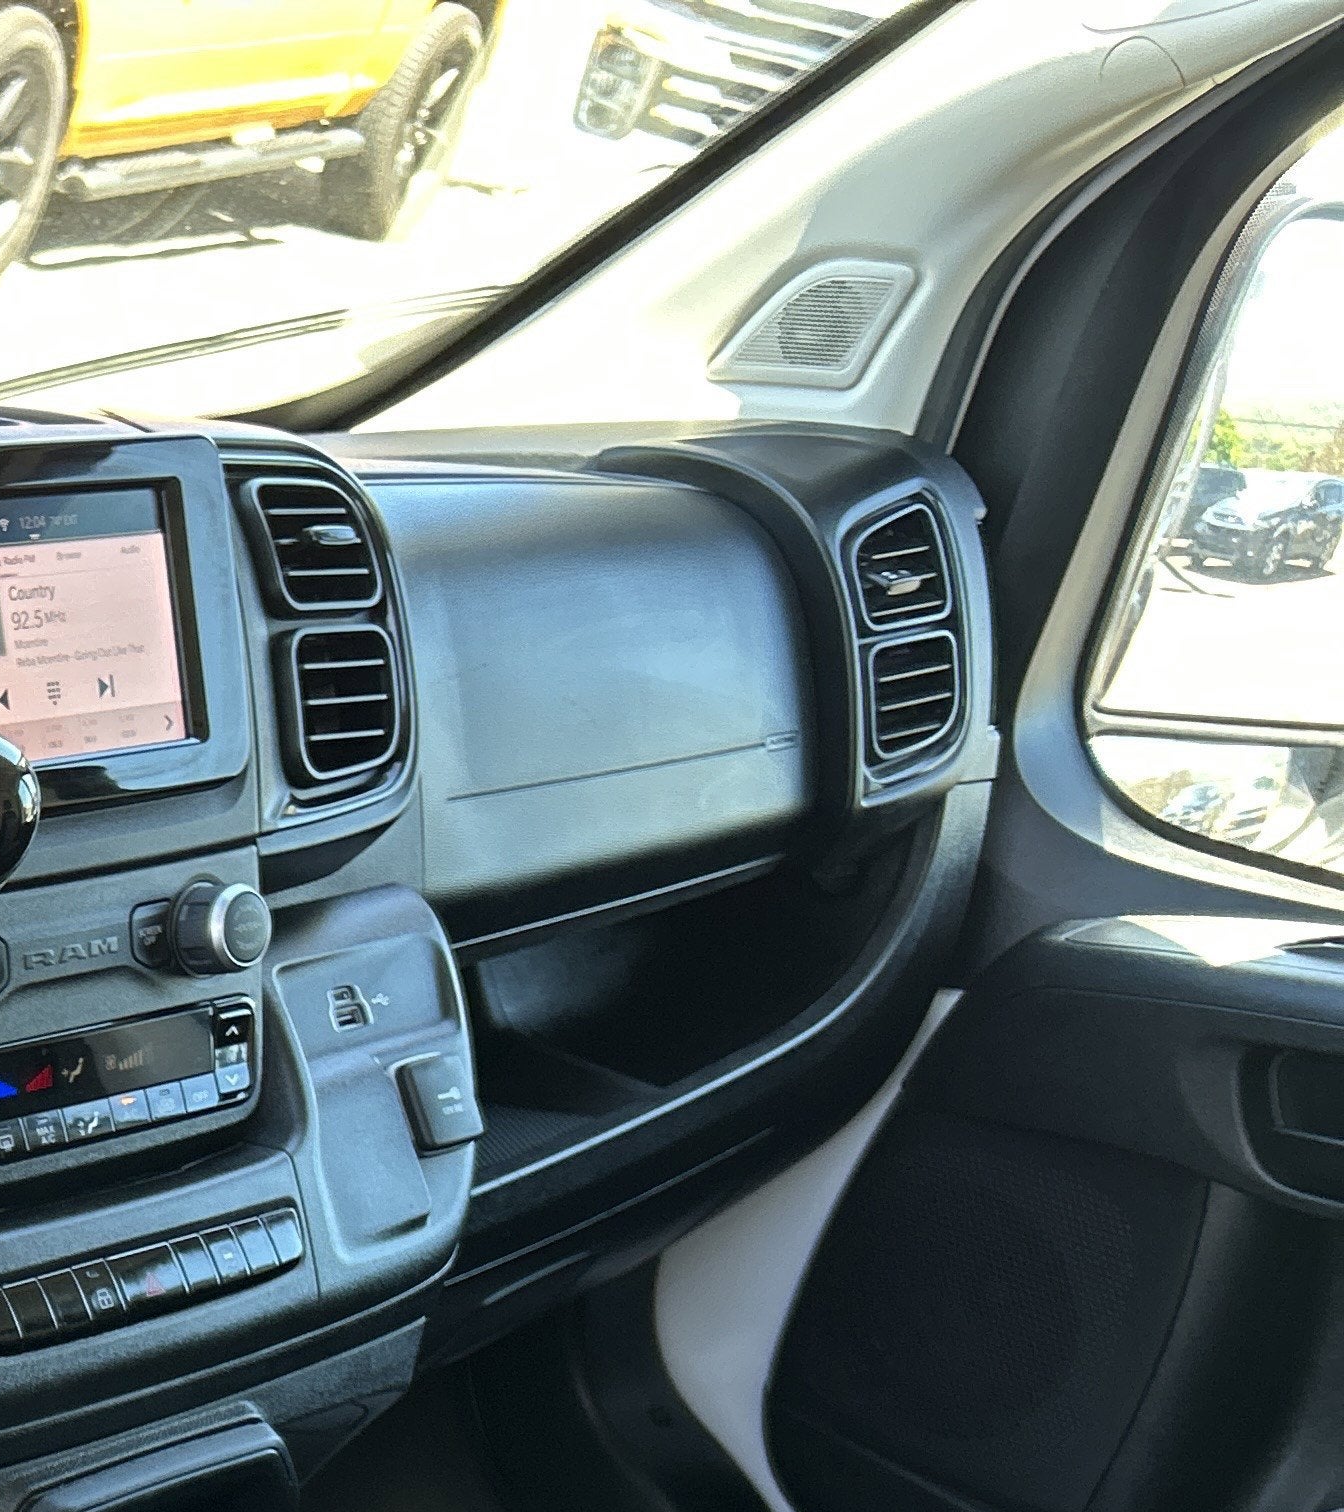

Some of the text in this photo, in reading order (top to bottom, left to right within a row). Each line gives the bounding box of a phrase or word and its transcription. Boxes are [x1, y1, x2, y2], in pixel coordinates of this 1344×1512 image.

[8, 585, 56, 602] Country
[11, 608, 44, 631] 92.5
[22, 936, 119, 970] RAM
